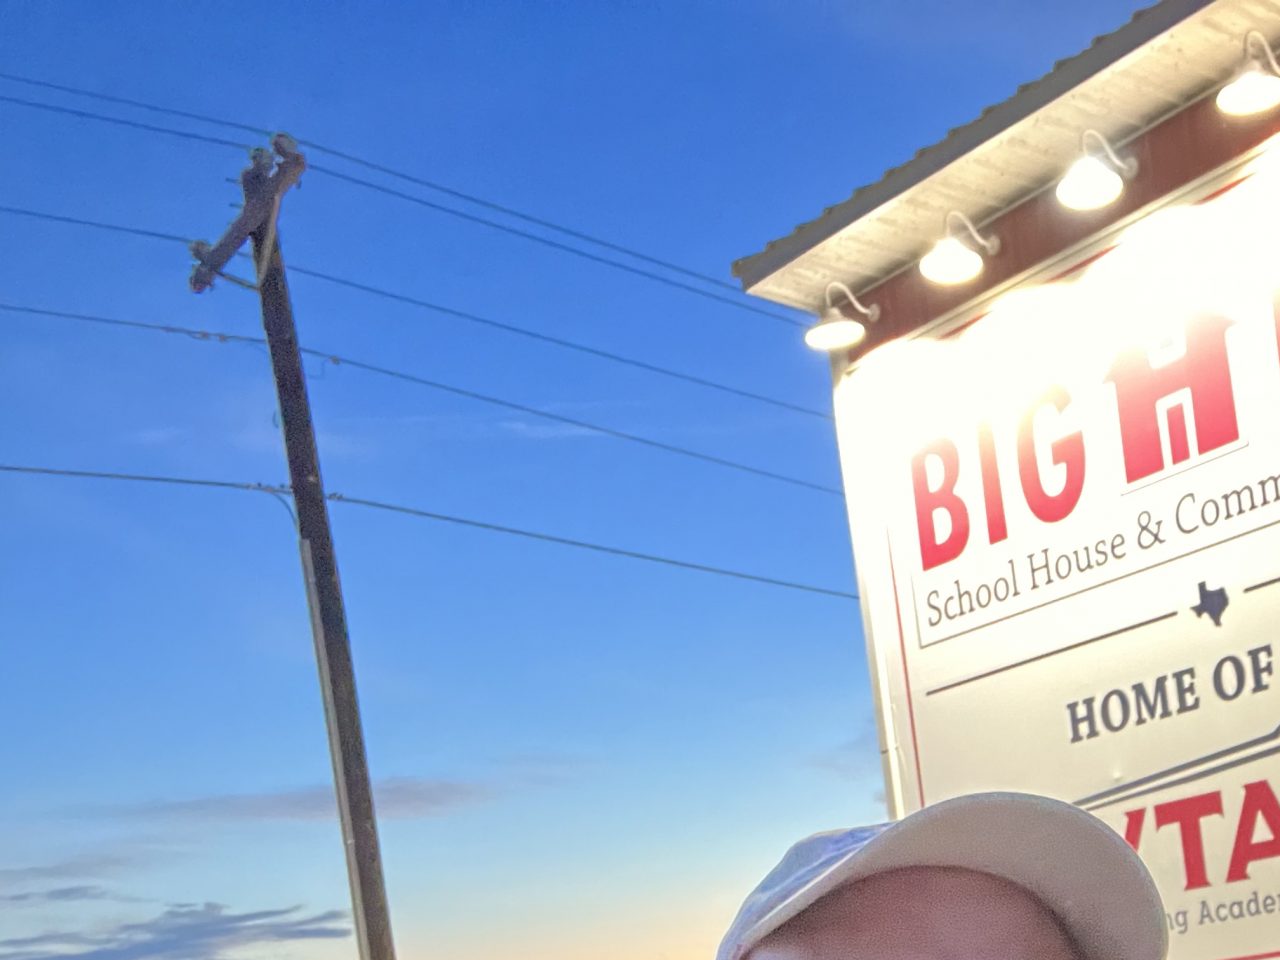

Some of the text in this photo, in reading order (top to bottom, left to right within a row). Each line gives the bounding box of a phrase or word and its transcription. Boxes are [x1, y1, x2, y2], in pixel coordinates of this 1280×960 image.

[911, 384, 1086, 571] BIG
[926, 559, 1021, 627] School
[1027, 533, 1127, 591] House
[1136, 510, 1166, 550] &
[1066, 667, 1201, 744] HOME
[1213, 644, 1273, 702] OF
